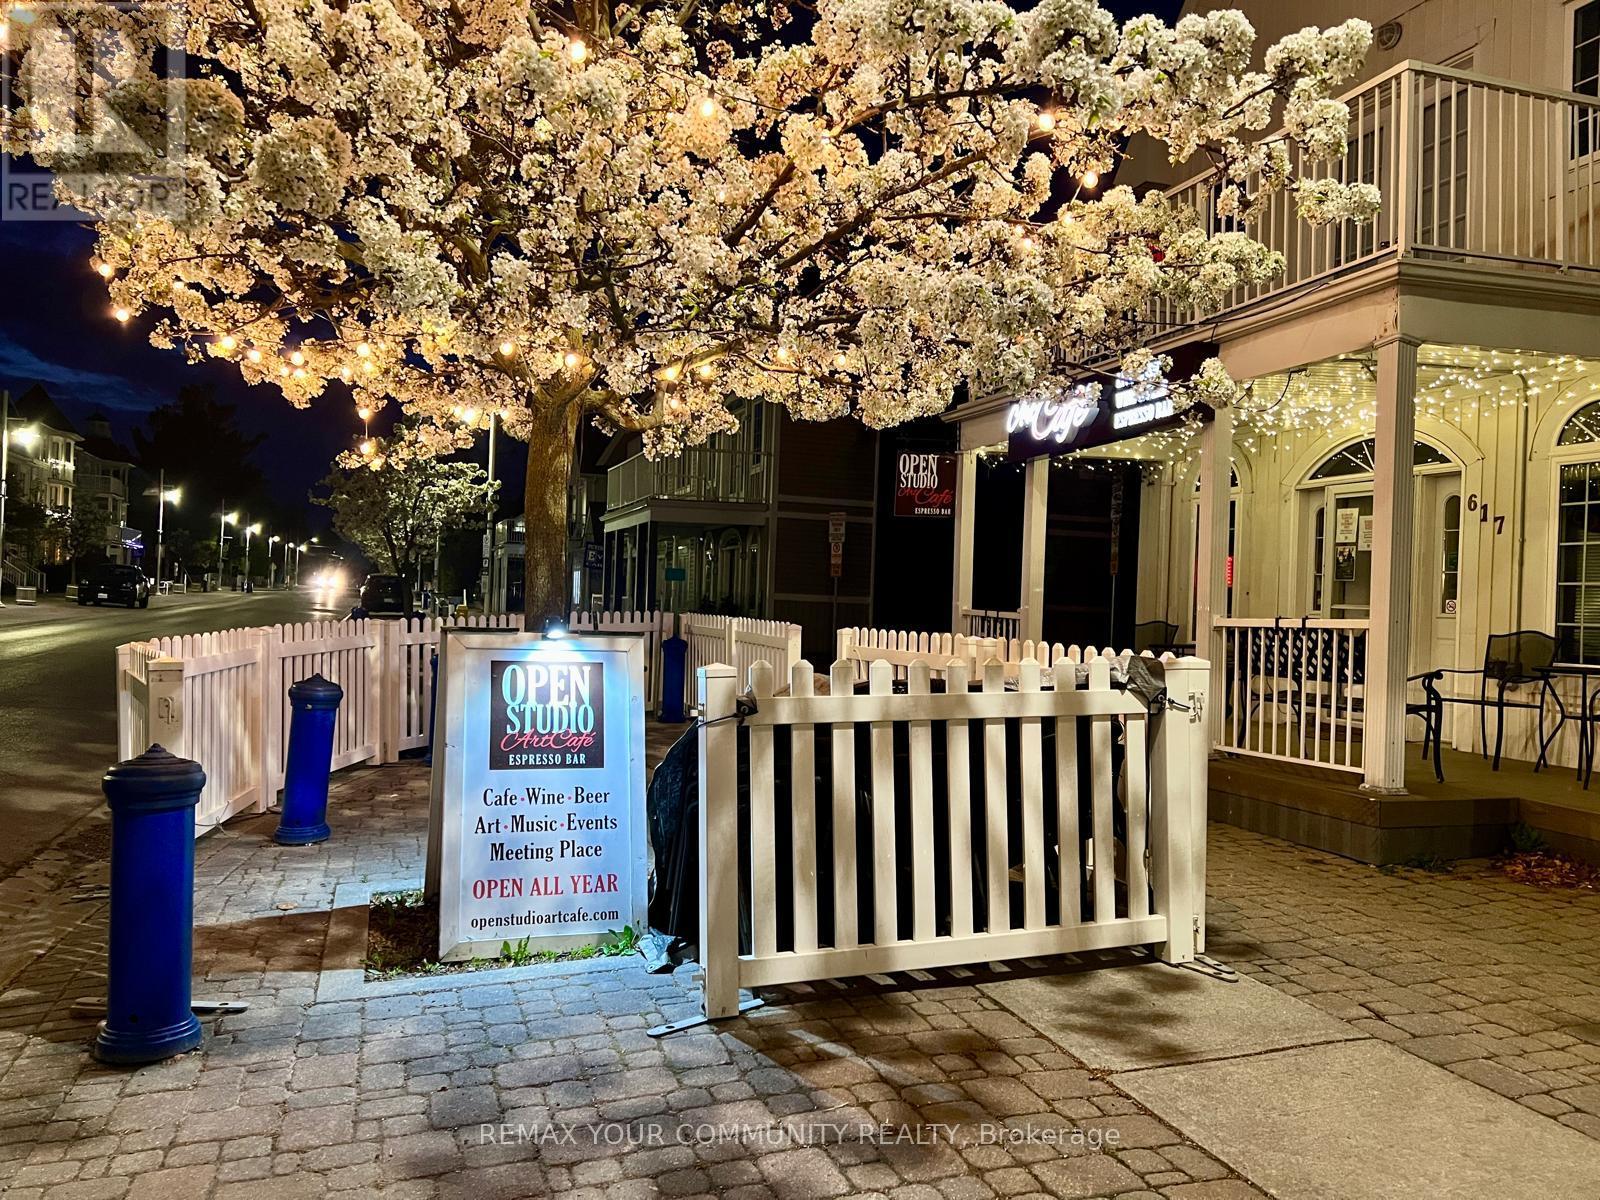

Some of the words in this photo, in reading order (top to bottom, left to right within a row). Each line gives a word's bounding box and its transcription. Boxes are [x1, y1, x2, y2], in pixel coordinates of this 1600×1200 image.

[899, 453, 940, 475] OPEN
[900, 473, 938, 489] STUDIO
[914, 507, 940, 515] ESPRESSO
[502, 664, 591, 706] OPEN
[506, 703, 595, 734] STUDIO
[508, 754, 562, 766] ESPRESSO
[565, 753, 586, 765] BAR
[483, 788, 517, 806] Cafe
[526, 787, 565, 805] Wine
[574, 786, 610, 804] Beer
[474, 815, 501, 834] Art
[510, 814, 558, 833] Music
[567, 812, 618, 831] Events
[490, 842, 554, 862] Meeting
[560, 839, 603, 858] Place
[472, 877, 524, 900] OPEN
[530, 876, 564, 897] ALL
[570, 873, 619, 895] YEAR
[471, 907, 620, 931] openstudioartcafe.com
